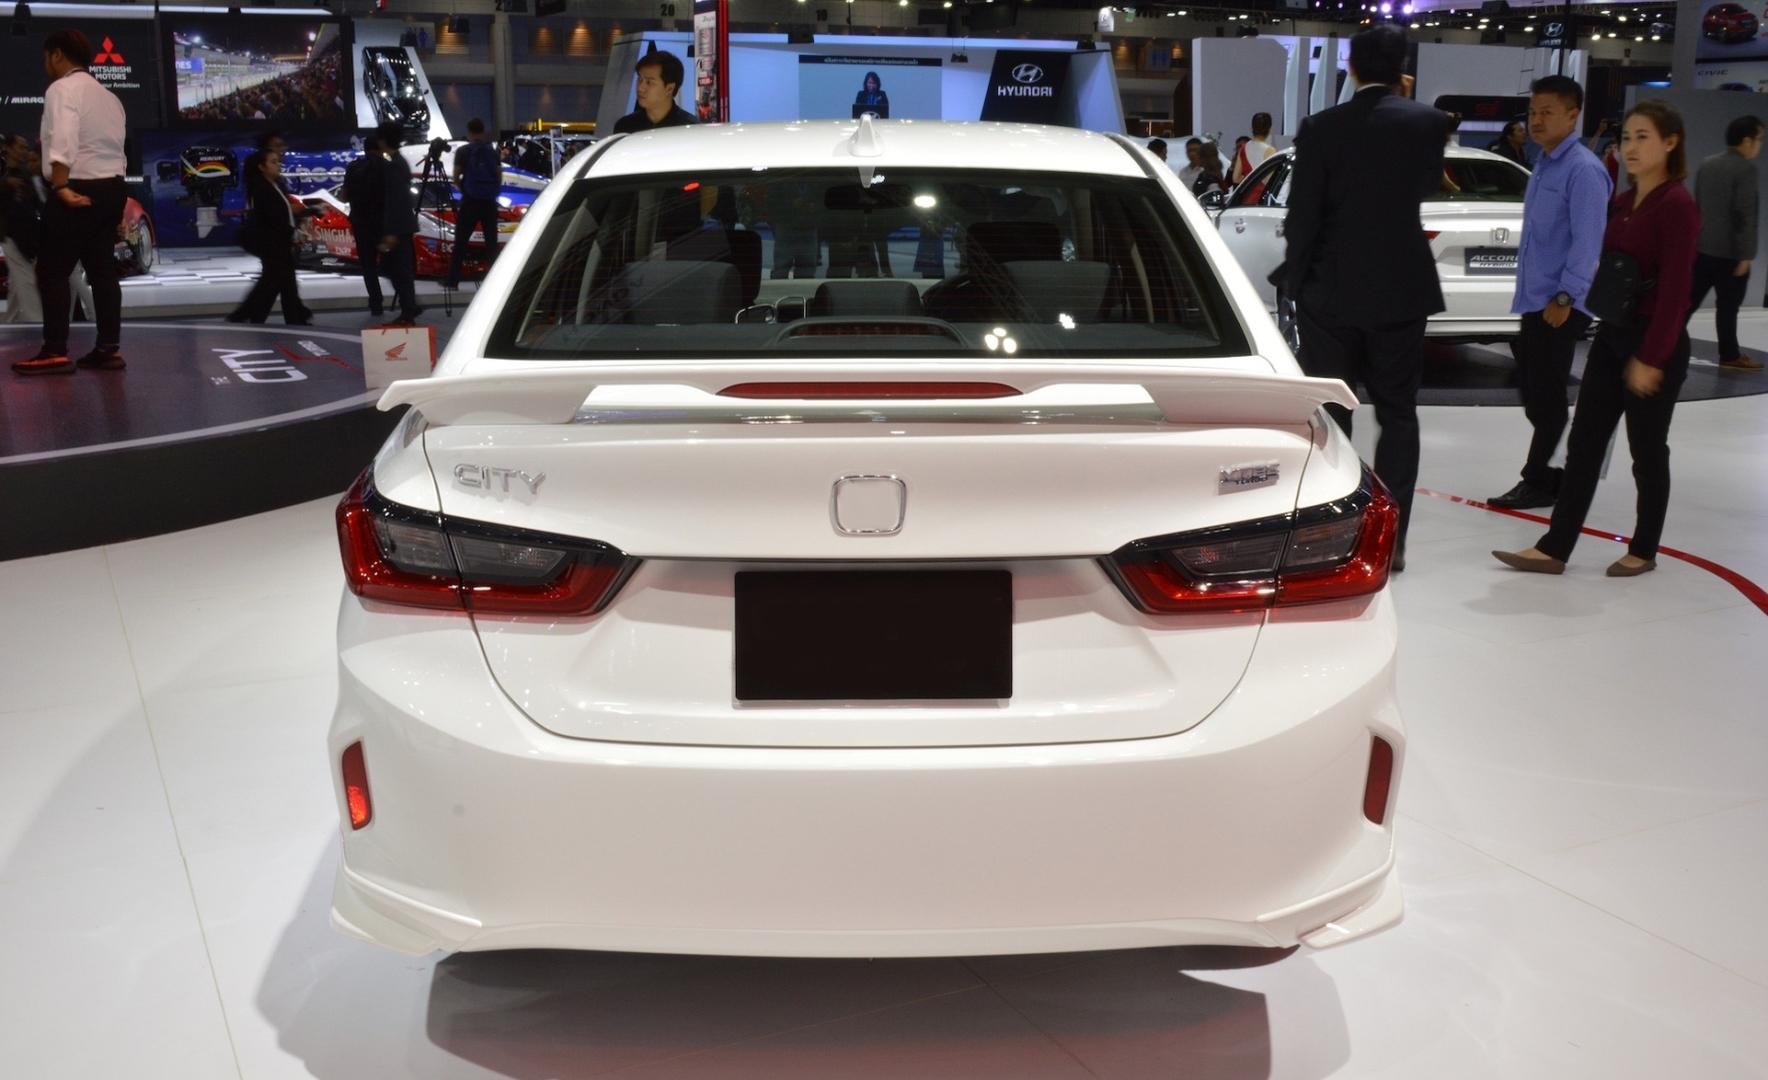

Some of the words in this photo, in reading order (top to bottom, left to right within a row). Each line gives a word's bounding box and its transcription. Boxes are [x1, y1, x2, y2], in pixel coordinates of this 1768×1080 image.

[660, 4, 675, 16] 20
[815, 9, 828, 21] 19
[997, 85, 1053, 97] HYUNDAI
[11, 96, 45, 104] MIRAG
[314, 225, 352, 243] SINGHA
[453, 463, 546, 495] CITY
